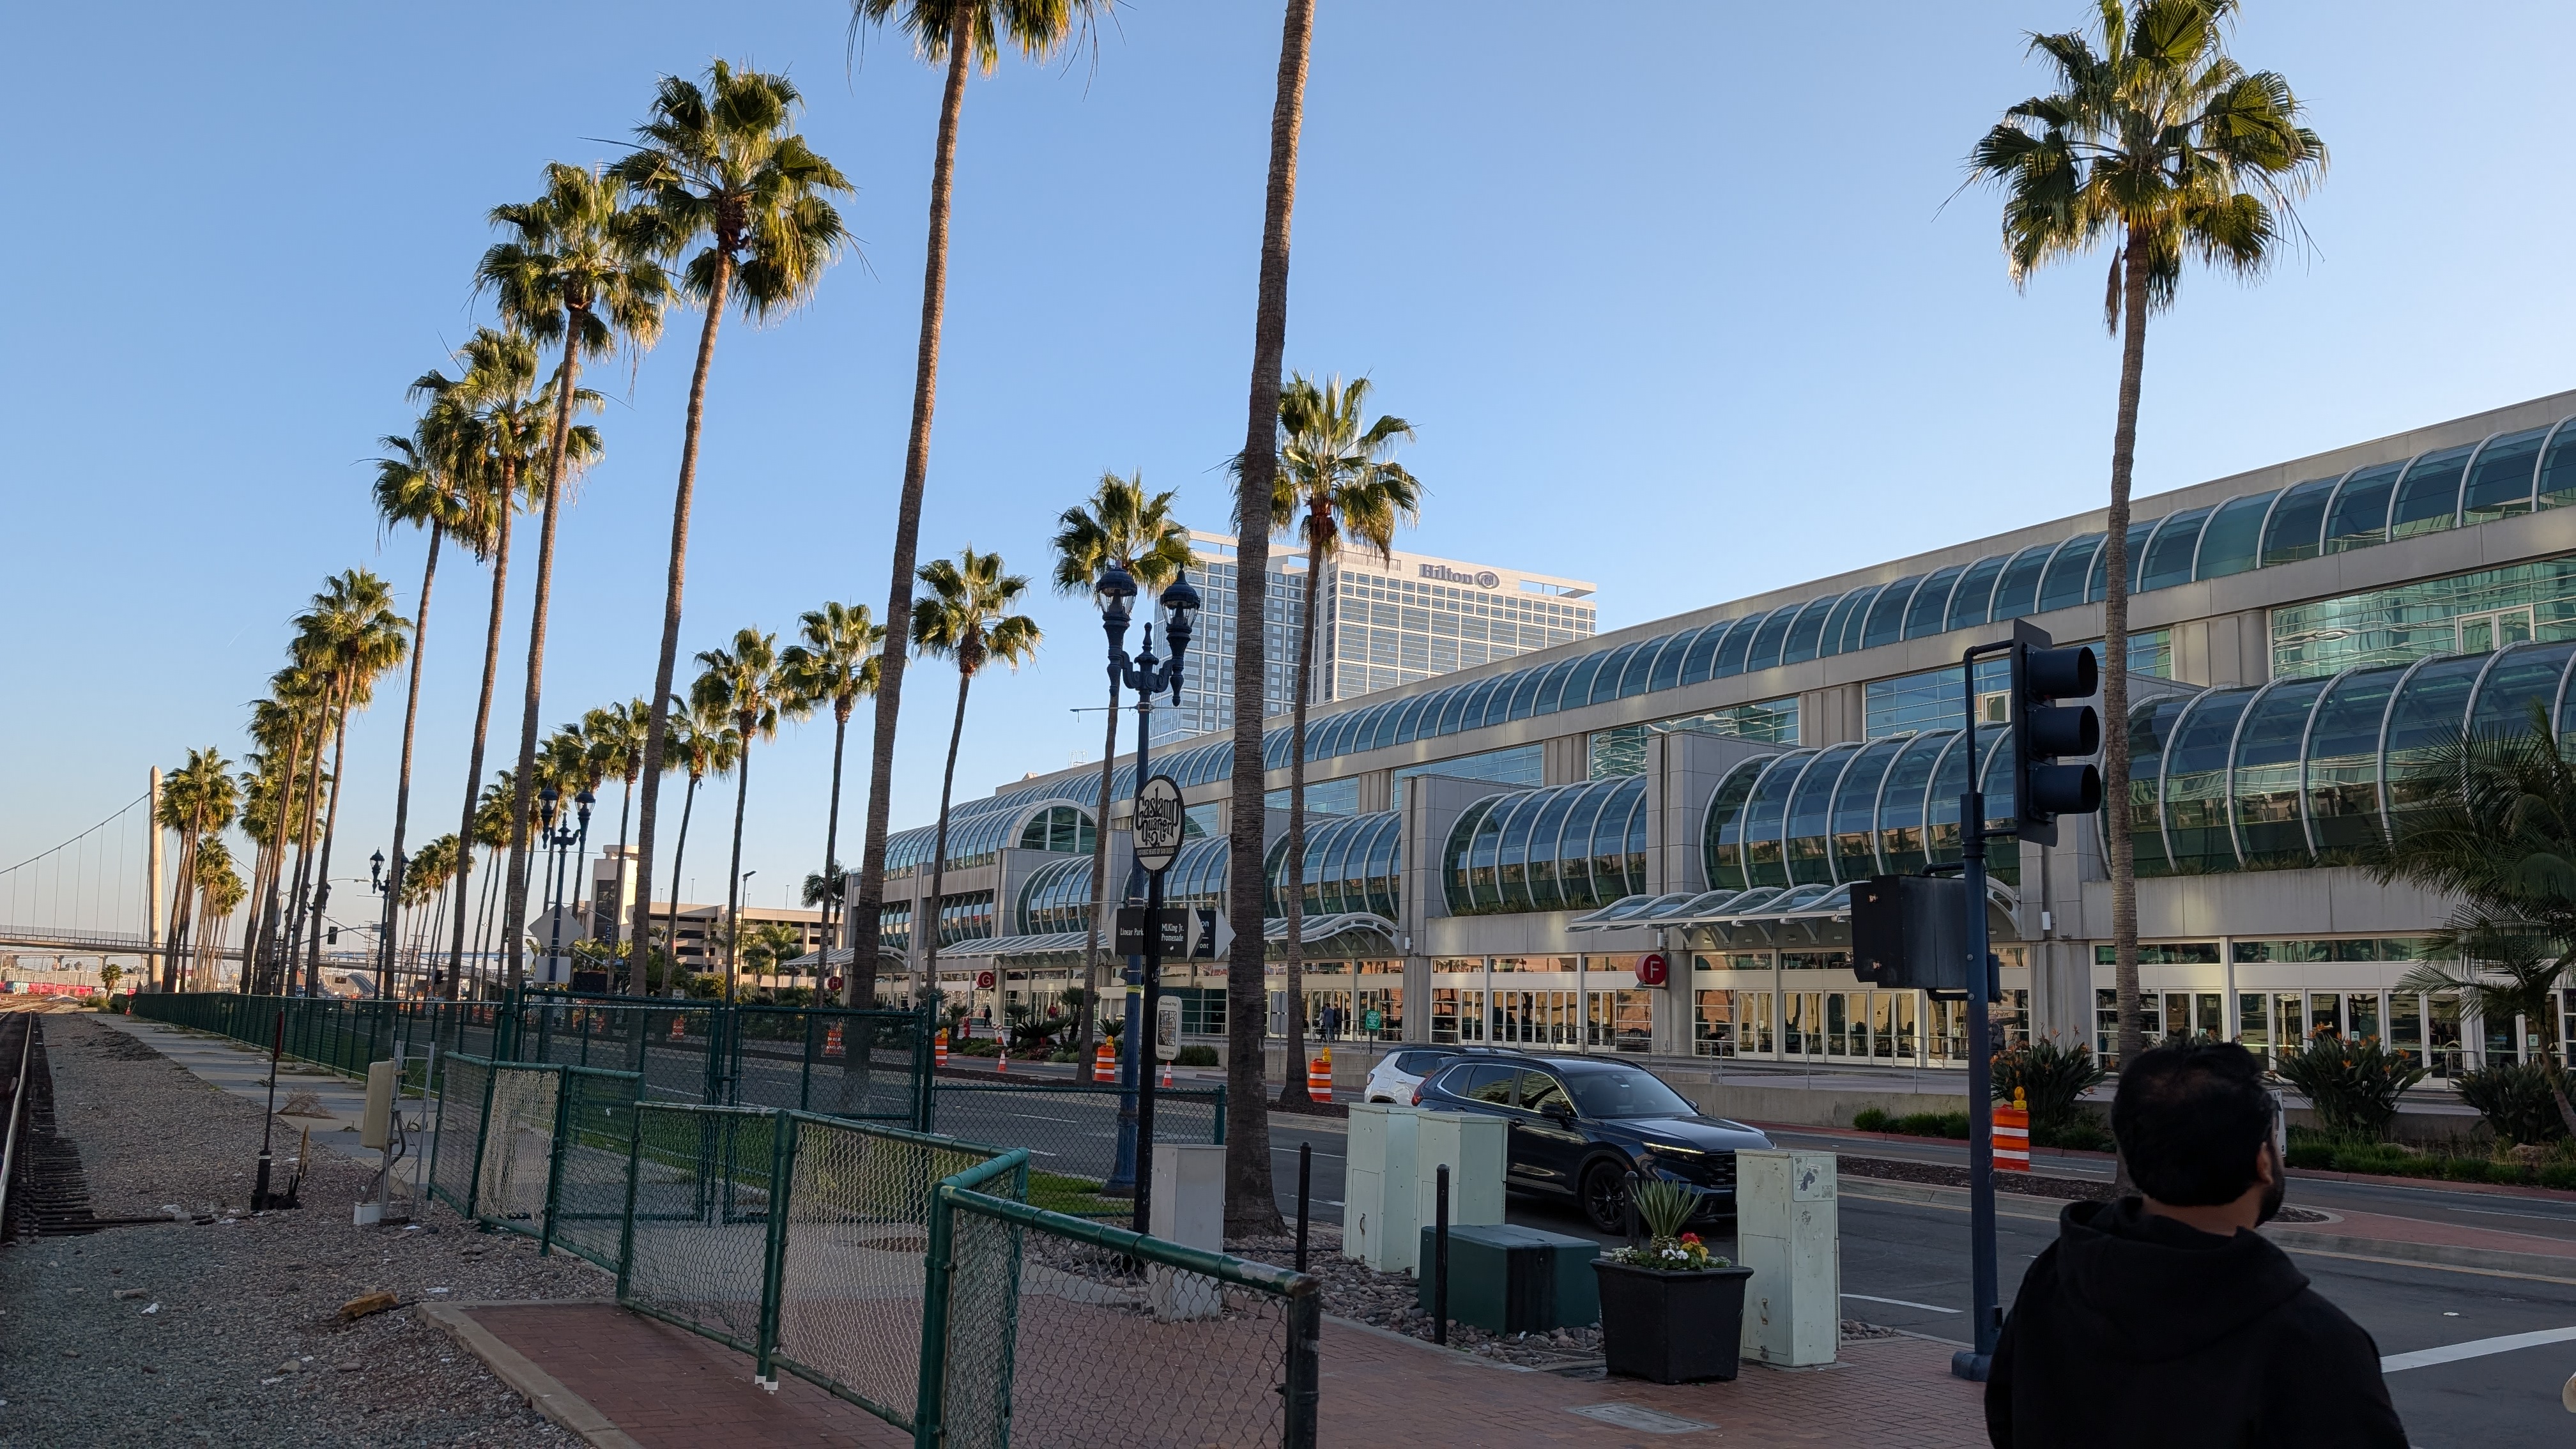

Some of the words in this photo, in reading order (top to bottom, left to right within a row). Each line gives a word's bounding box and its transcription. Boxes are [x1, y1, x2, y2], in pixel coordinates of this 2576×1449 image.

[1418, 564, 1474, 585] Hilton
[1135, 786, 1180, 831] Gaslamp
[1141, 817, 1174, 847] Quarter
[1134, 928, 1144, 936] Park
[1162, 933, 1183, 942] Promenade
[1650, 961, 1660, 978] F
[832, 978, 839, 987] H
[981, 974, 991, 985] G
